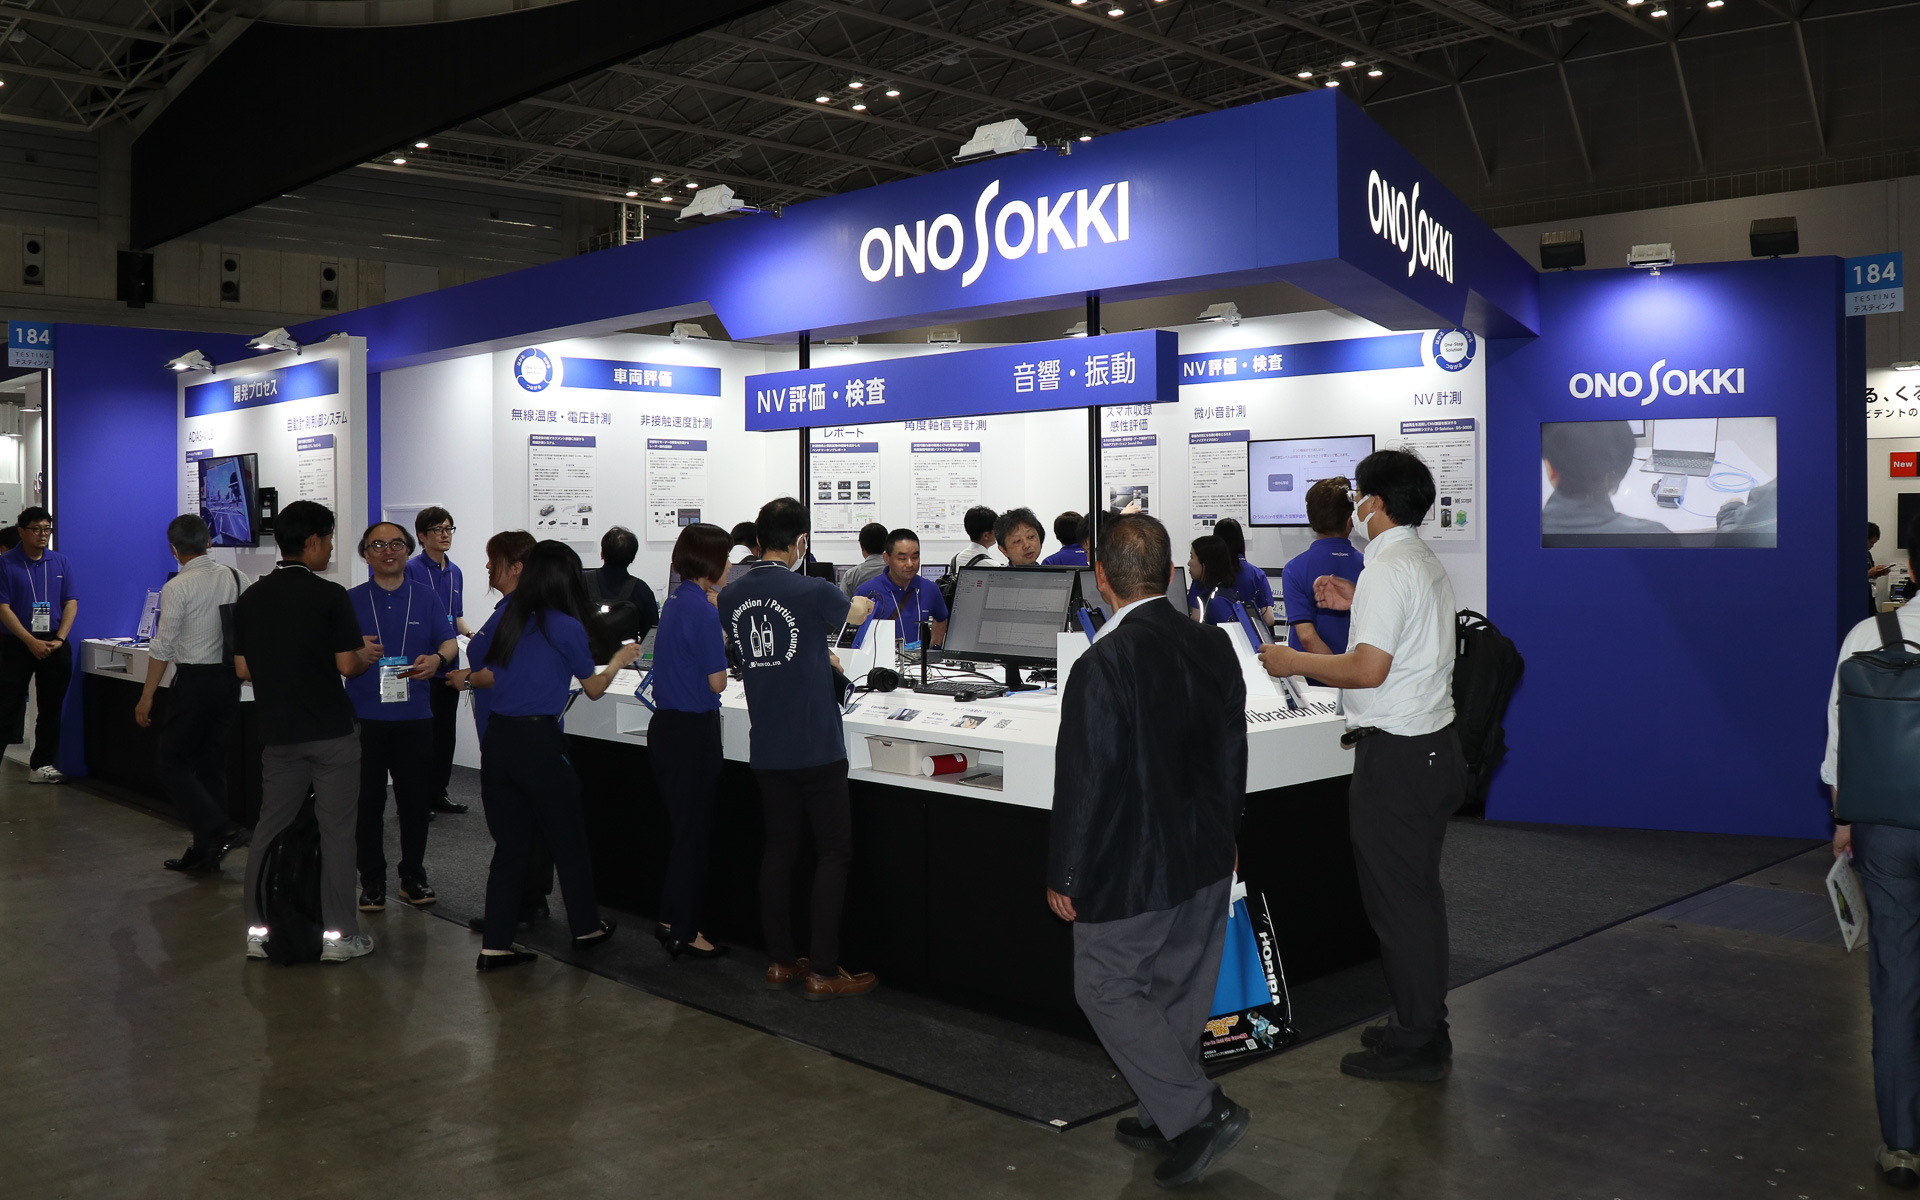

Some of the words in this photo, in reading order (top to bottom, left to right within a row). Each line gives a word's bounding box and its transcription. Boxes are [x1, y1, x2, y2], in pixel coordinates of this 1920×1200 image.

[1853, 261, 1896, 285] 184
[1854, 292, 1896, 303] TESTING
[1853, 302, 1896, 313] テスティング
[15, 327, 50, 345] 184
[15, 351, 50, 359] TESTING
[1013, 351, 1136, 394] 音響・振動
[1183, 353, 1283, 378] NV評価・検査
[613, 366, 673, 388] 車両評価
[233, 379, 278, 403] 開発プロセス
[756, 377, 887, 414] NV評価・検査
[511, 408, 612, 425] 無線温度・電圧計測
[1106, 403, 1153, 418] スマホ収録
[1194, 404, 1247, 420] 微小音計測
[287, 410, 348, 432] 自動計測制御システム
[640, 414, 713, 430] 非接触速度計測
[904, 419, 987, 431] 角度軸信号計測
[1109, 418, 1149, 432] 感性評価
[823, 427, 864, 438] レポート
[732, 598, 762, 622] Vibration
[770, 600, 796, 627] Particle
[785, 628, 800, 662] Counter
[1258, 931, 1281, 1006] HORIBA
